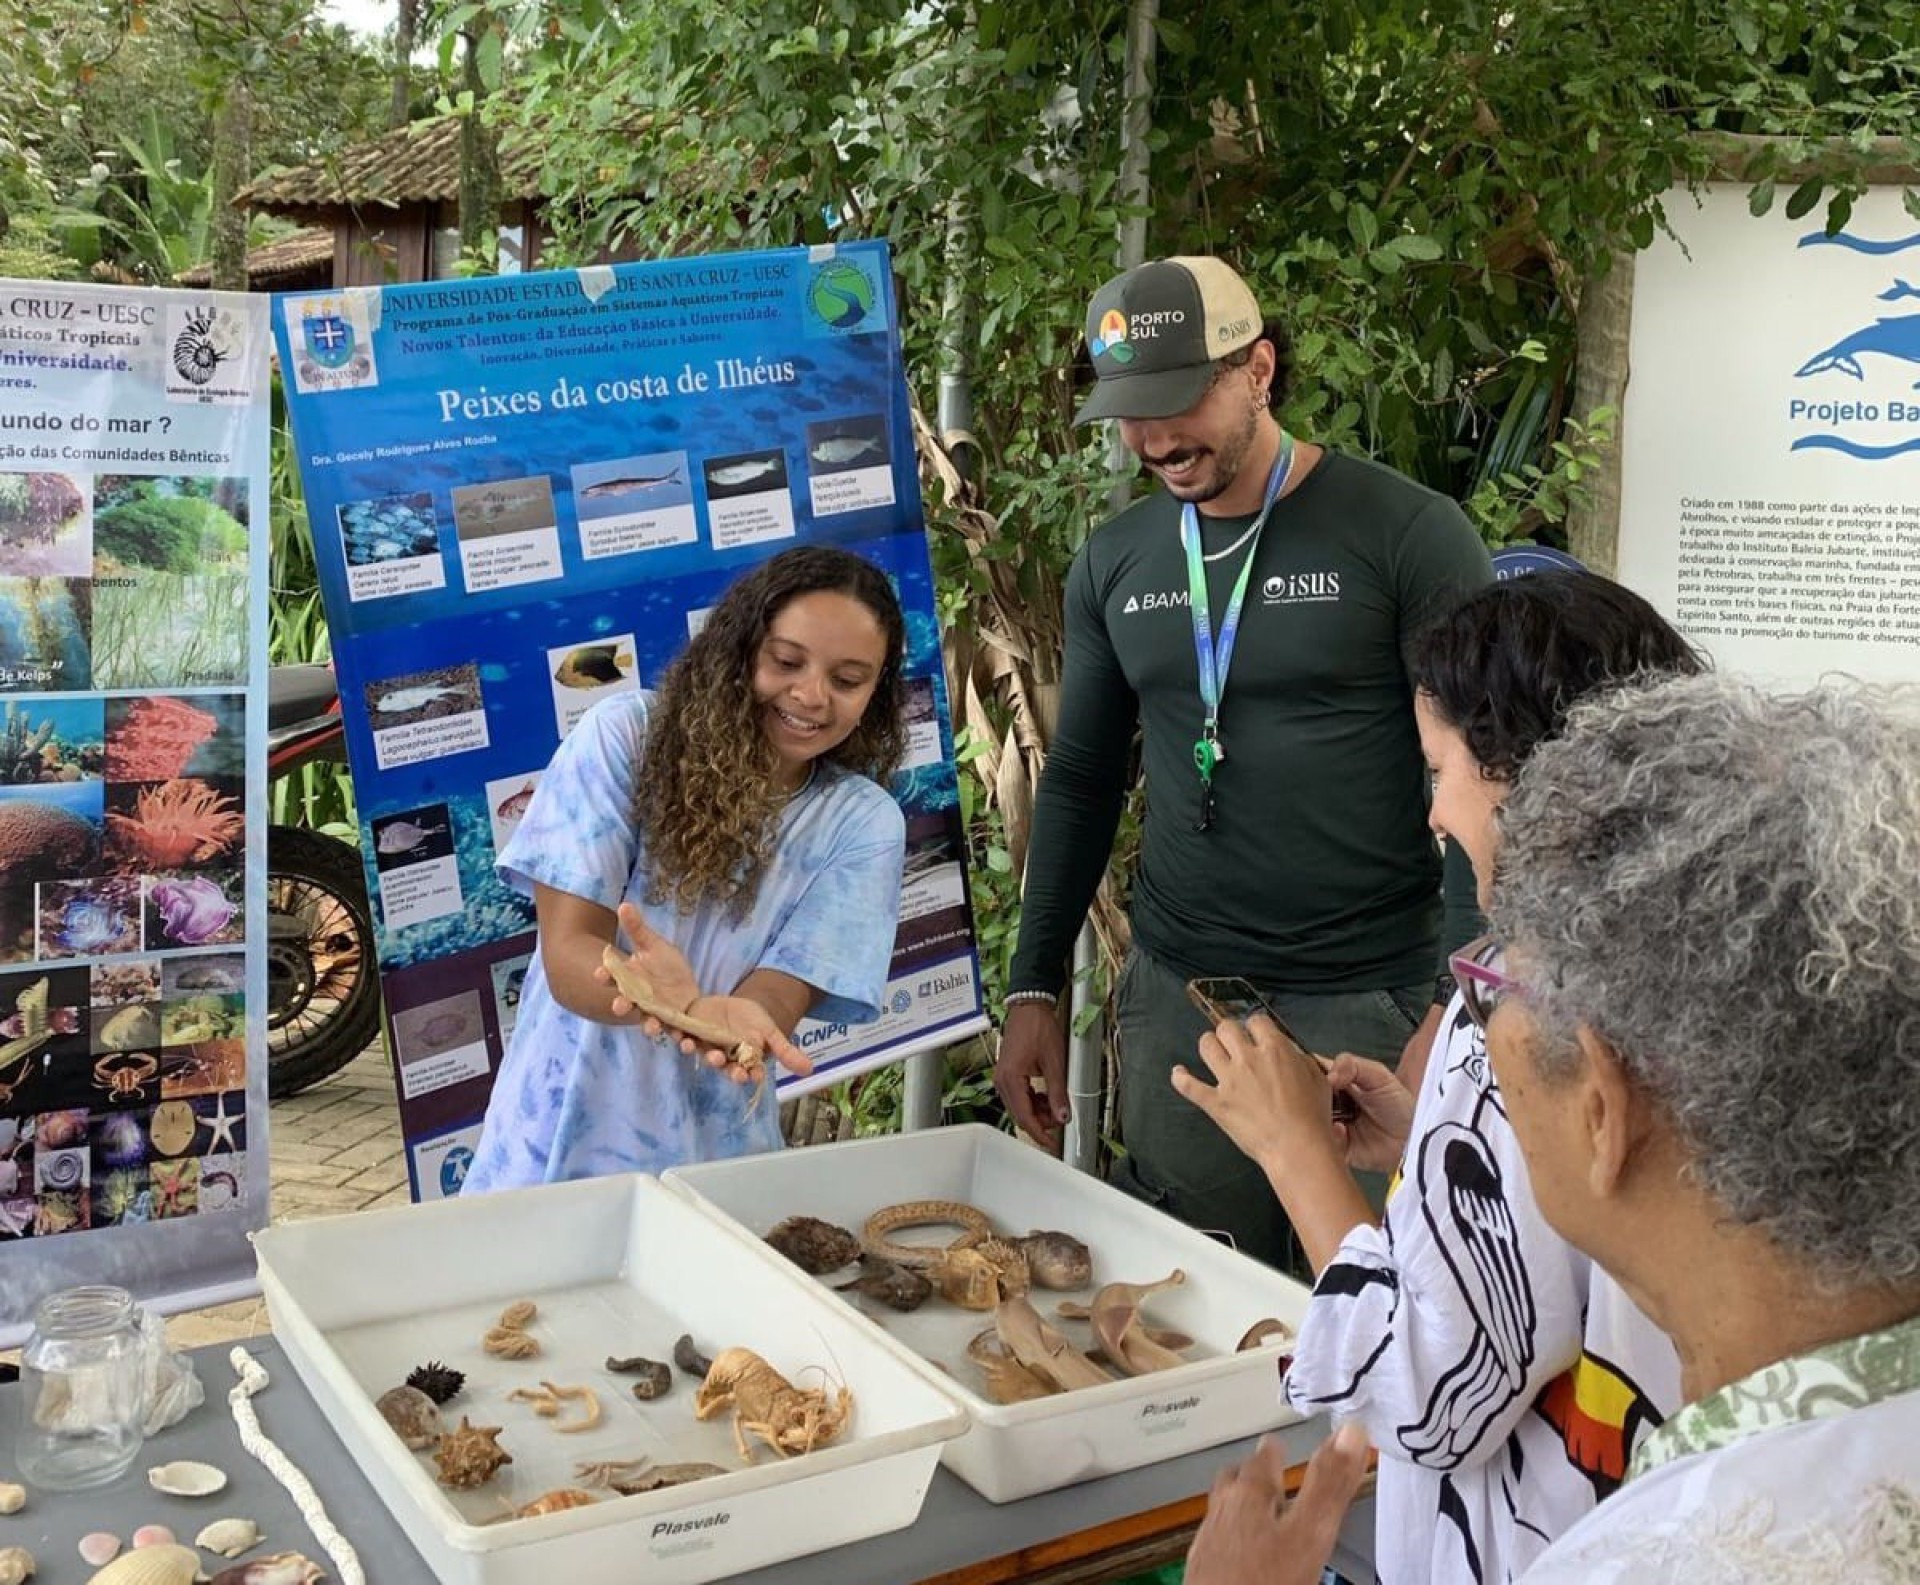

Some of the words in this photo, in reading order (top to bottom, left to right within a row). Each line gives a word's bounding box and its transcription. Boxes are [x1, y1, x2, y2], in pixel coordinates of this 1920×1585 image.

[617, 275, 640, 294] DE
[641, 268, 696, 291] SANTA
[697, 267, 740, 286] CRUZ
[754, 263, 792, 281] UESC
[10, 297, 75, 320] CRUZ
[97, 303, 156, 326] UESC
[393, 318, 464, 333] Programa
[467, 312, 483, 324] de
[612, 298, 668, 312] Sistemas
[731, 286, 784, 303] Tropicais
[1131, 310, 1185, 326] PORTO
[56, 328, 141, 348] Tropicais
[402, 340, 452, 355] Novos
[536, 327, 554, 340] da
[558, 320, 627, 337] Educação
[1131, 326, 1161, 340] SUL
[437, 385, 543, 422] Peixes
[551, 376, 588, 409] da
[595, 375, 671, 405] costa
[676, 363, 709, 393] de
[715, 356, 796, 389] Ilhéus
[1791, 399, 1880, 426] Projeto
[1887, 401, 1920, 422] Ba
[69, 413, 100, 432] do
[108, 415, 152, 433] mar
[159, 416, 172, 434] ?
[30, 445, 57, 459] das
[62, 445, 166, 462] Comunidades
[169, 448, 231, 464] Bênticas
[376, 443, 431, 457] Rodrigues
[433, 439, 462, 451] Alves
[464, 434, 497, 446] Rocha
[1680, 498, 1715, 509] Criado
[1718, 501, 1734, 510] em
[1738, 500, 1764, 510] 1988
[1768, 503, 1797, 511] como
[1800, 503, 1828, 515] parte
[1830, 504, 1849, 513] das
[1852, 504, 1882, 516] ações
[1885, 504, 1898, 515] de
[1741, 514, 1781, 524] visando
[1784, 516, 1824, 526] estudar
[1837, 519, 1882, 530] proteger
[1723, 528, 1755, 538] muito
[1818, 530, 1832, 540] de
[1680, 541, 1724, 551] trabalho
[1726, 541, 1739, 551] do
[1743, 541, 1789, 553] Instituto
[1792, 543, 1823, 554] Baleia
[1679, 554, 1726, 564] dedicada
[1738, 556, 1802, 569] conservação
[1855, 560, 1900, 572] fundada
[1678, 568, 1700, 579] pela
[1704, 568, 1754, 581] Petrobras,
[1758, 570, 1802, 582] trabalha
[1805, 574, 1821, 583] em
[1849, 574, 1887, 586] frentes
[1678, 583, 1701, 593] para
[1703, 585, 1755, 596] assegurar
[1758, 586, 1778, 597] que
[1857, 588, 1875, 599] das
[1709, 599, 1732, 607] com
[1829, 604, 1842, 612] na
[1846, 602, 1872, 614] Praia
[1876, 604, 1890, 614] do
[1784, 614, 1798, 624] de
[1800, 616, 1834, 626] outras
[1878, 618, 1892, 628] de
[1725, 627, 1738, 636] na
[1741, 627, 1793, 640] promoção
[1796, 629, 1810, 639] do
[1813, 630, 1854, 641] turismo
[1857, 631, 1870, 642] de
[934, 973, 970, 996] Bahia
[801, 1022, 849, 1048] CNPq
[1142, 1395, 1202, 1418] Plasvale
[650, 1512, 731, 1538] Plasvale
